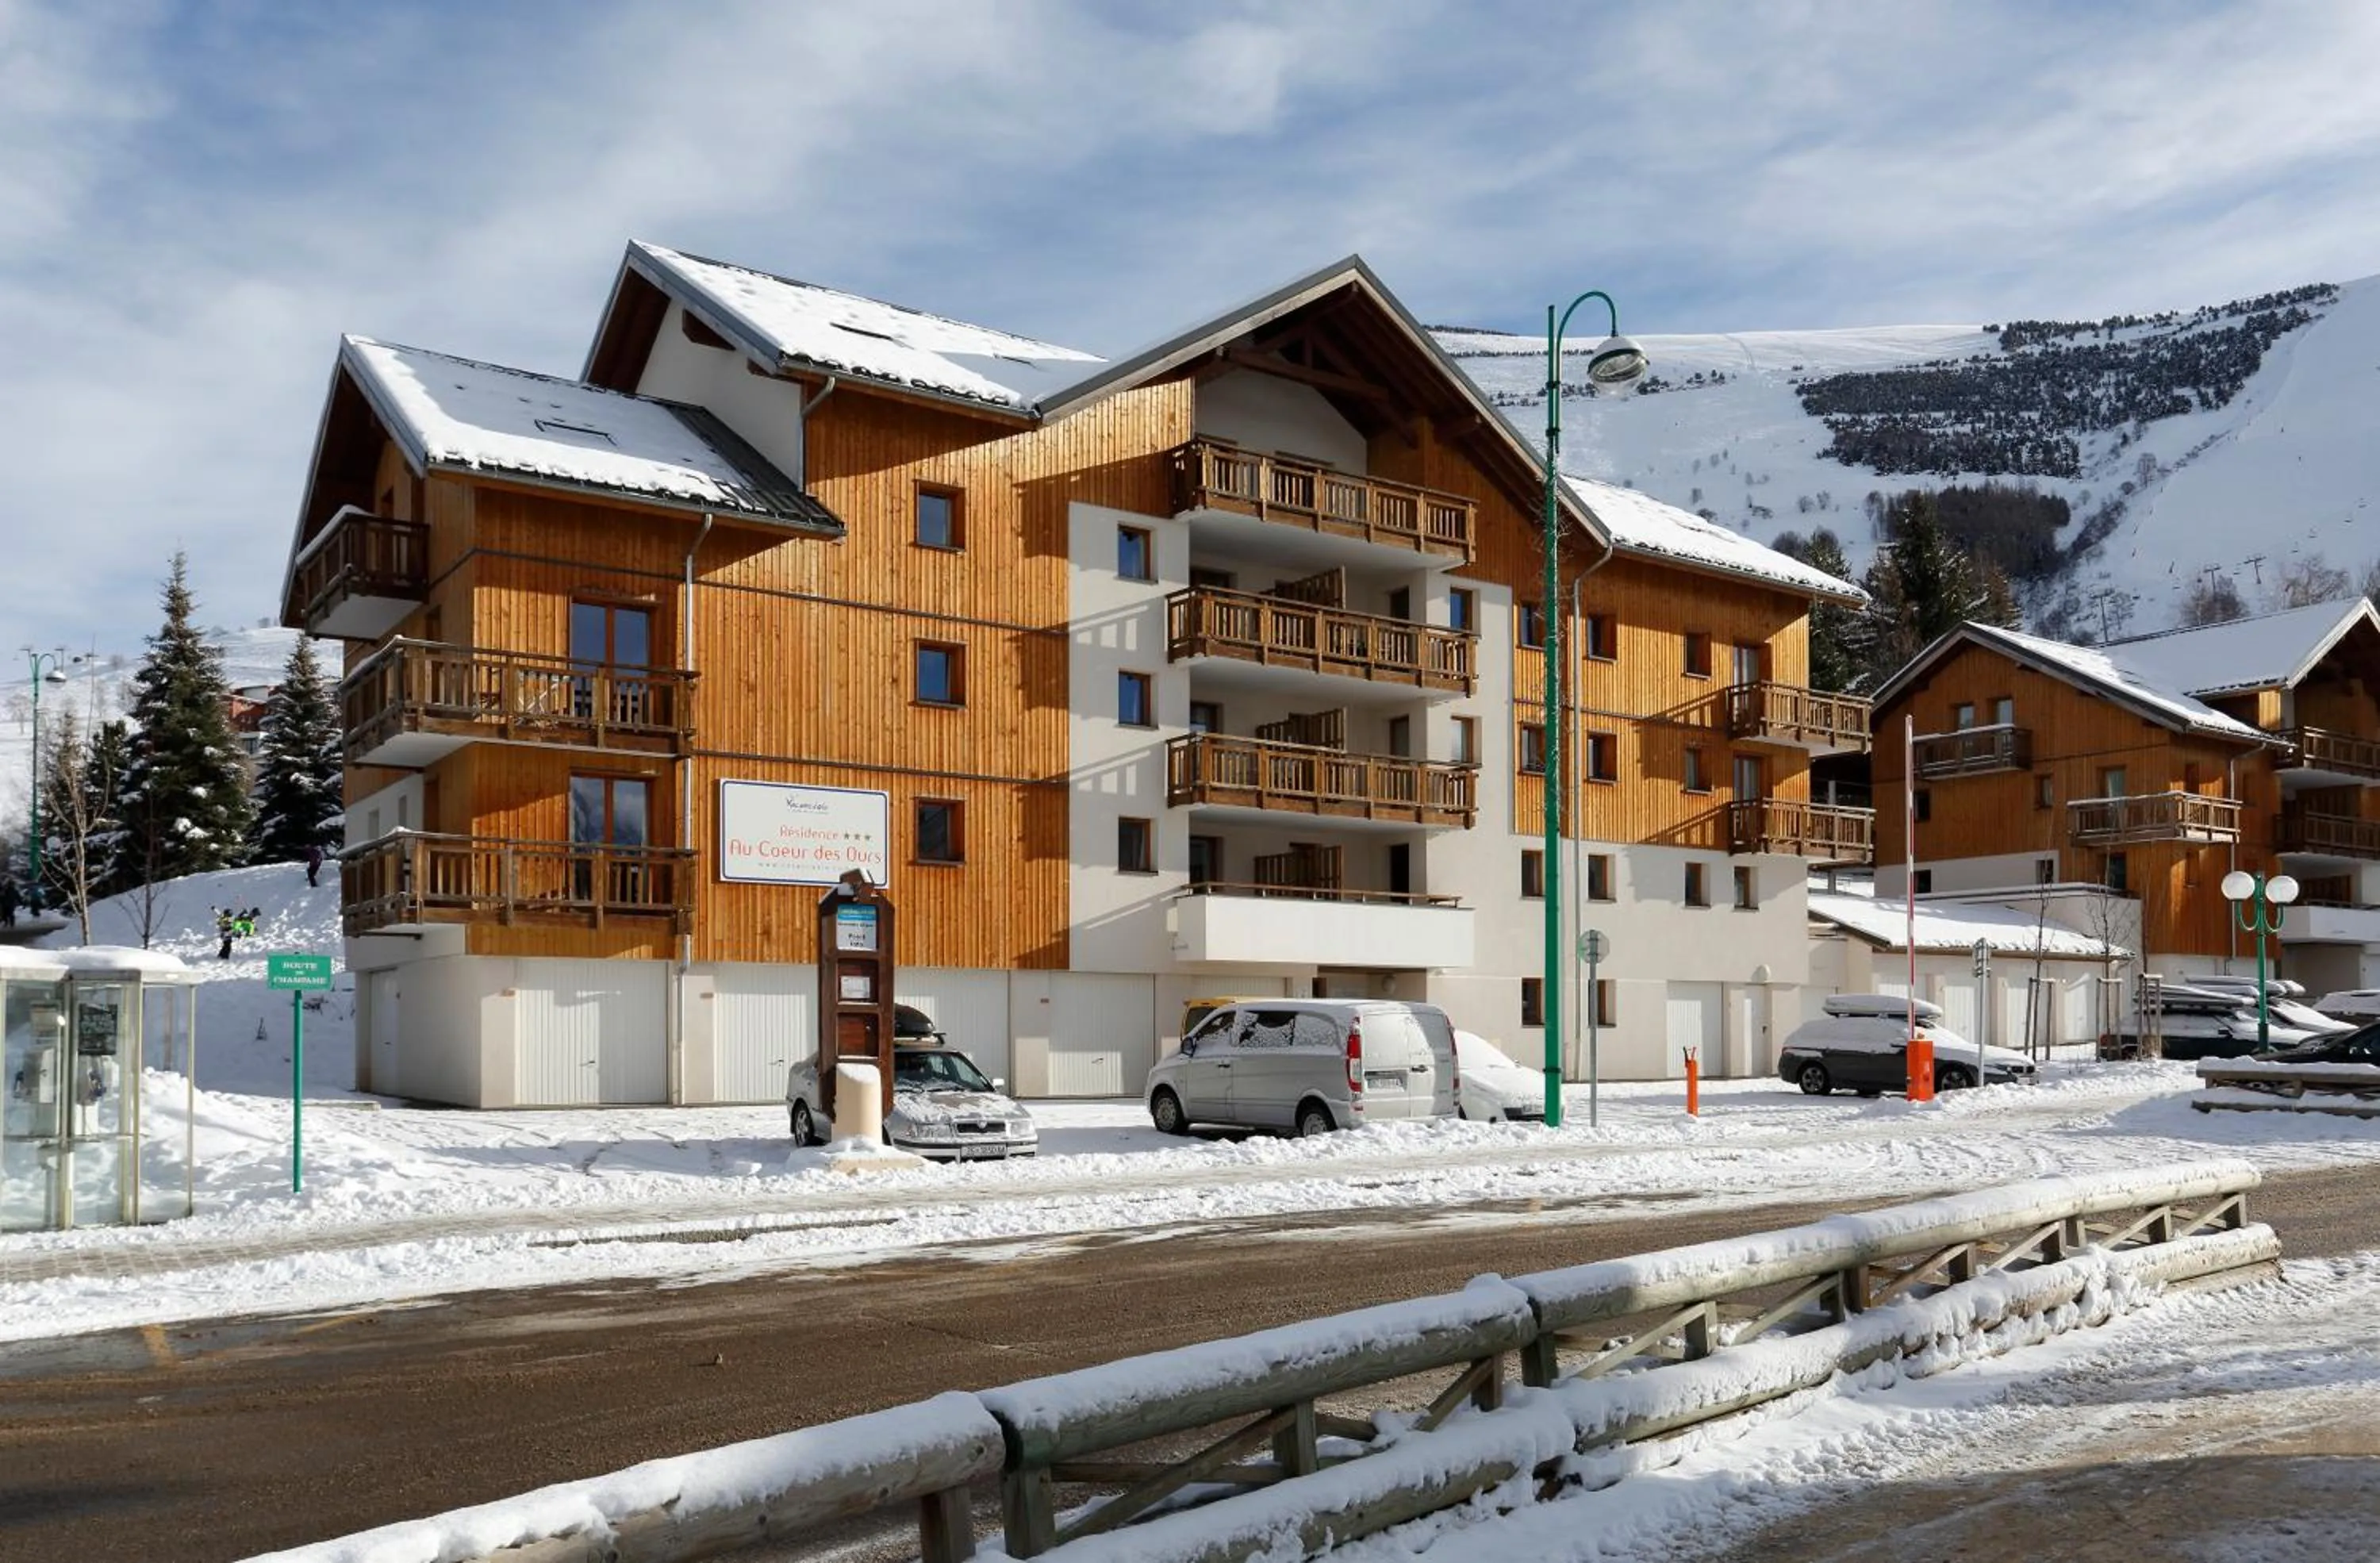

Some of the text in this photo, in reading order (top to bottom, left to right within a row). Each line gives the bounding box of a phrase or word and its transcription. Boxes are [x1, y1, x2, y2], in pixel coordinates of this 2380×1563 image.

[779, 825, 839, 840] Résidence
[729, 839, 752, 857] Au
[814, 846, 840, 861] des
[846, 846, 883, 864] Ours
